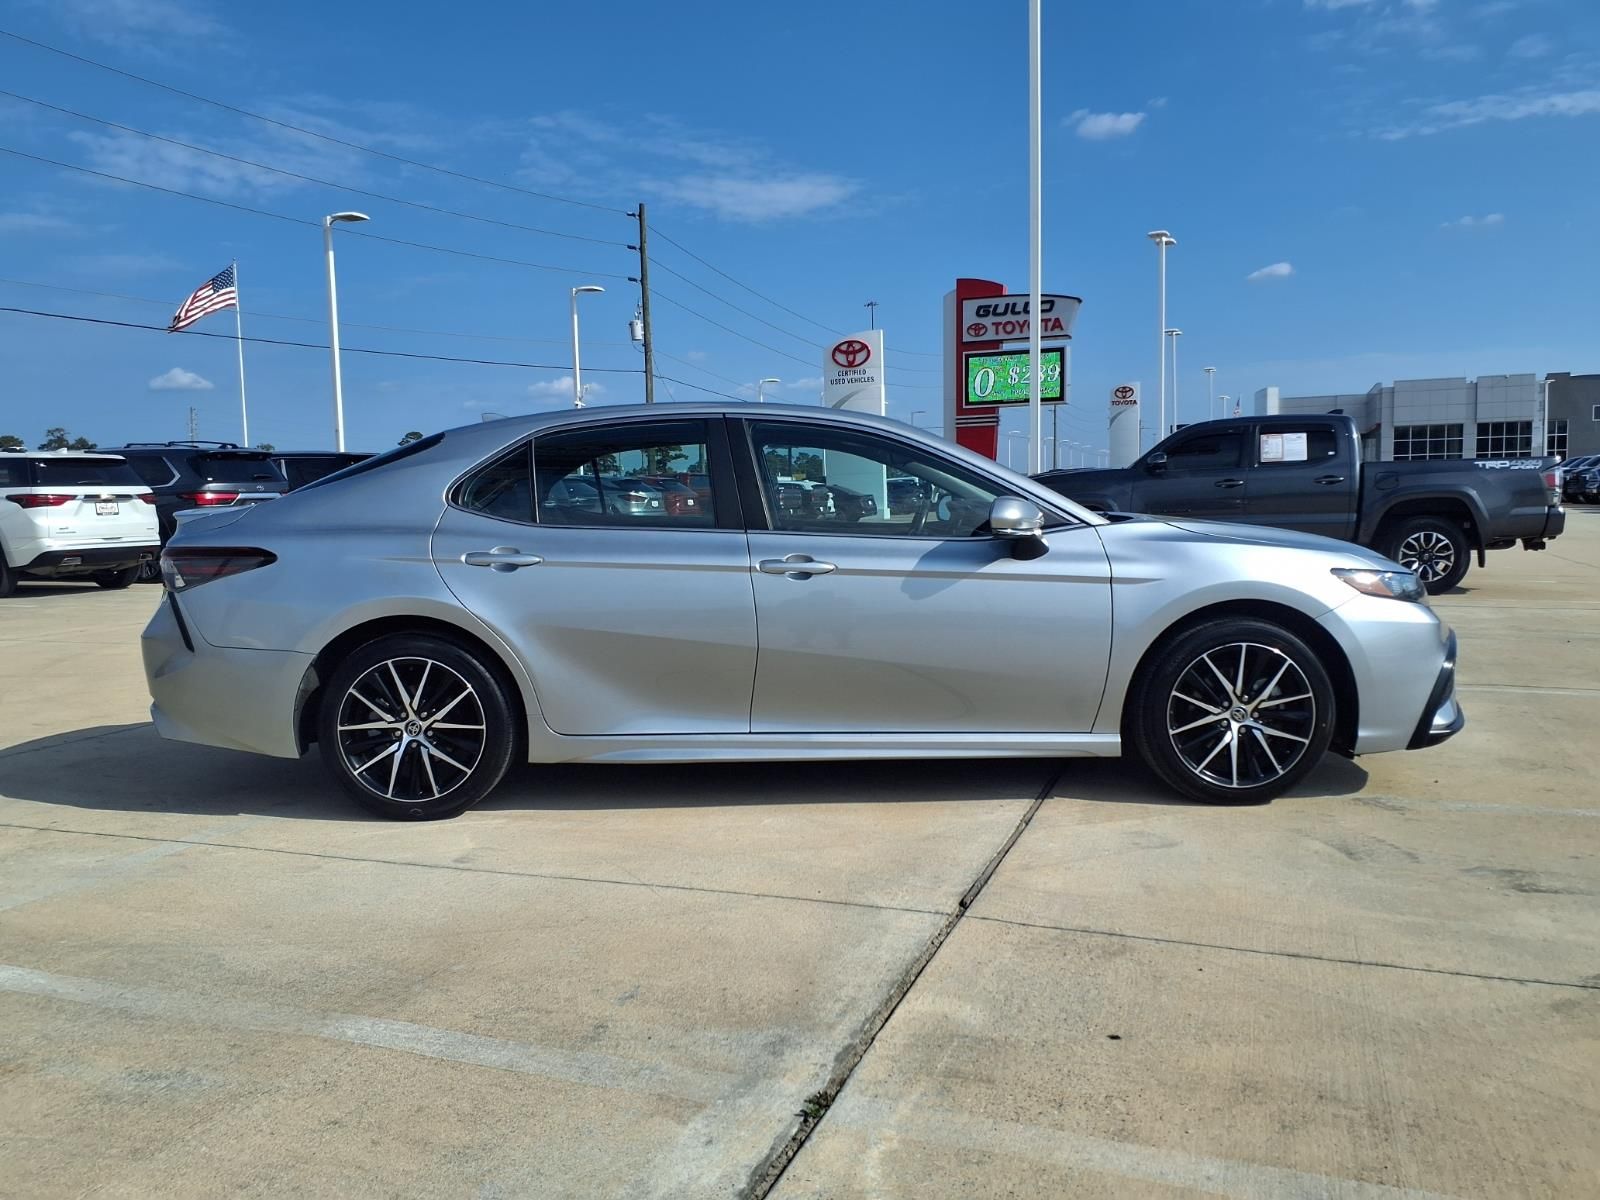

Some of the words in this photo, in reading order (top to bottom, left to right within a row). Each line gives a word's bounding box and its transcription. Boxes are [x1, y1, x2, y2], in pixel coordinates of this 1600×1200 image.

[976, 300, 1055, 318] GULLO
[992, 318, 1064, 335] TOYTA
[847, 376, 875, 384] VEHICLES
[1474, 460, 1510, 469] TRD
